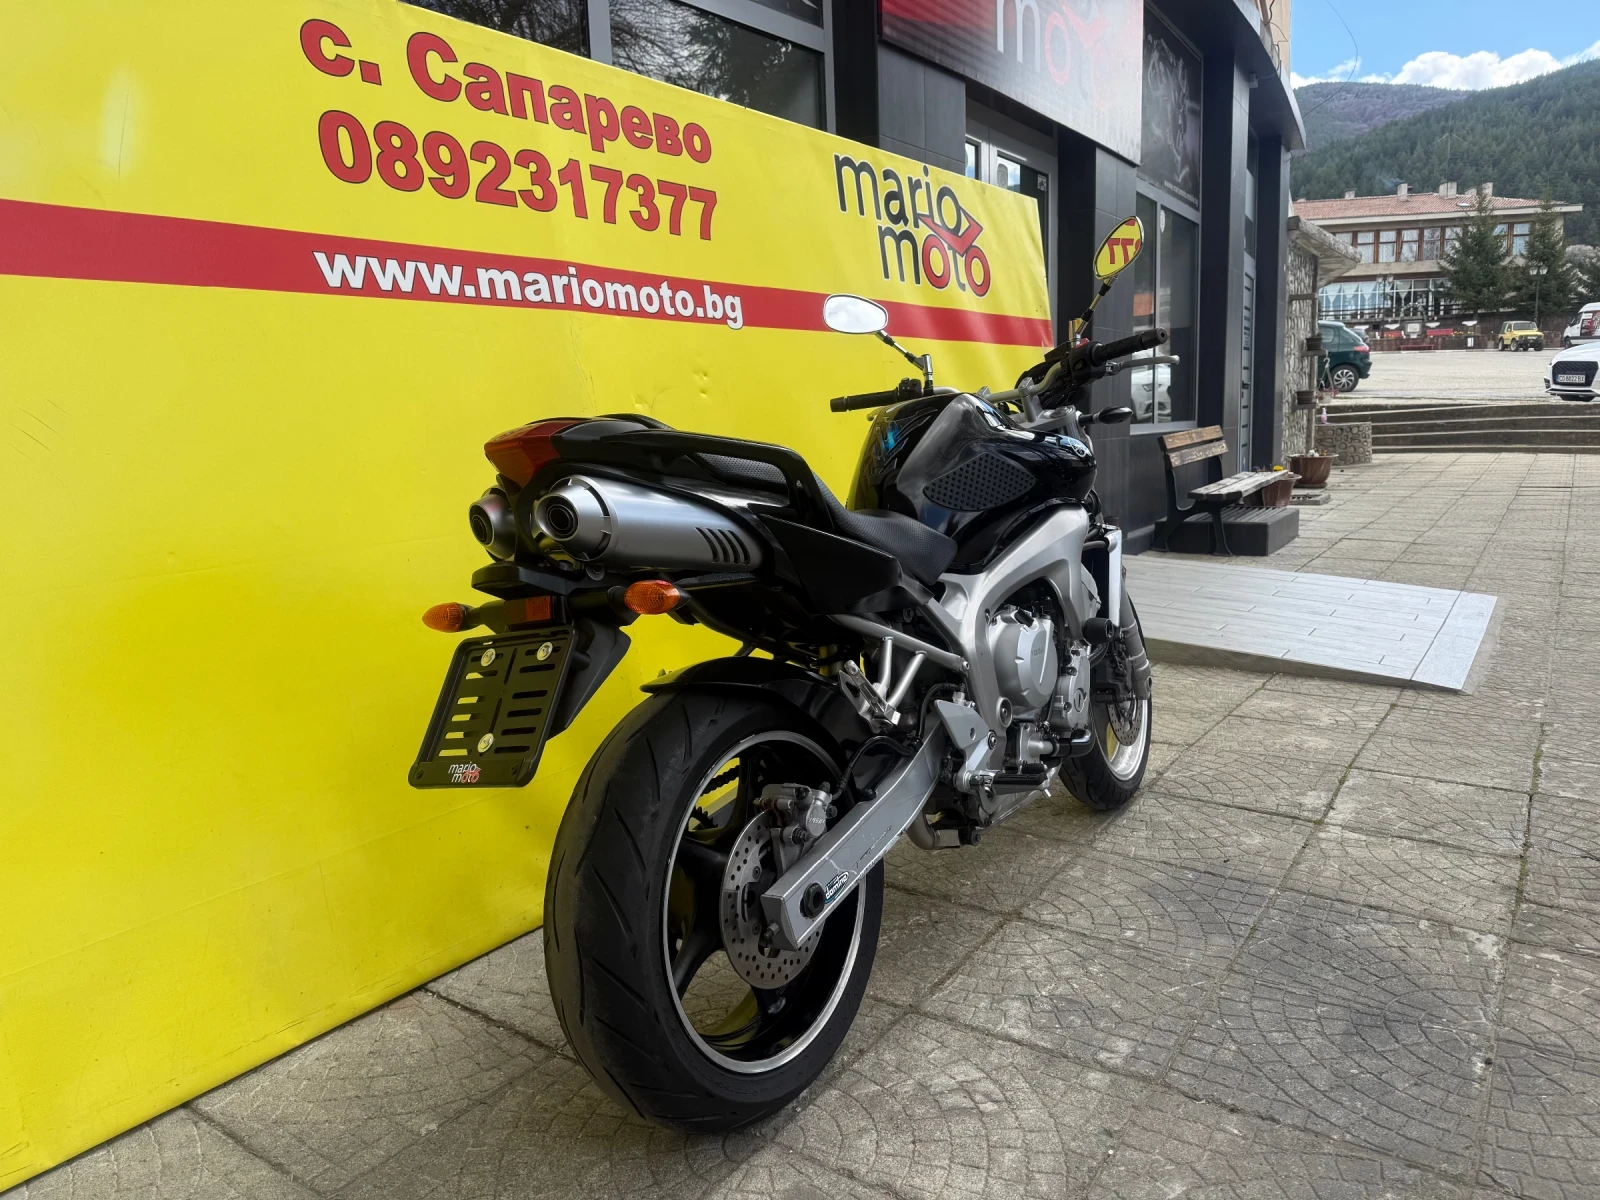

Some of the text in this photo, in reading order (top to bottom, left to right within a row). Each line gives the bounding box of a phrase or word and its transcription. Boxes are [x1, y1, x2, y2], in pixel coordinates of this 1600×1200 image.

[300, 19, 712, 164] с. Сапарево
[318, 110, 717, 241] 0892317377
[833, 153, 963, 236] mario
[313, 251, 744, 330] www.mariomoto.bg
[877, 222, 991, 297] moto
[448, 761, 478, 774] mario
[451, 773, 480, 784] moto
